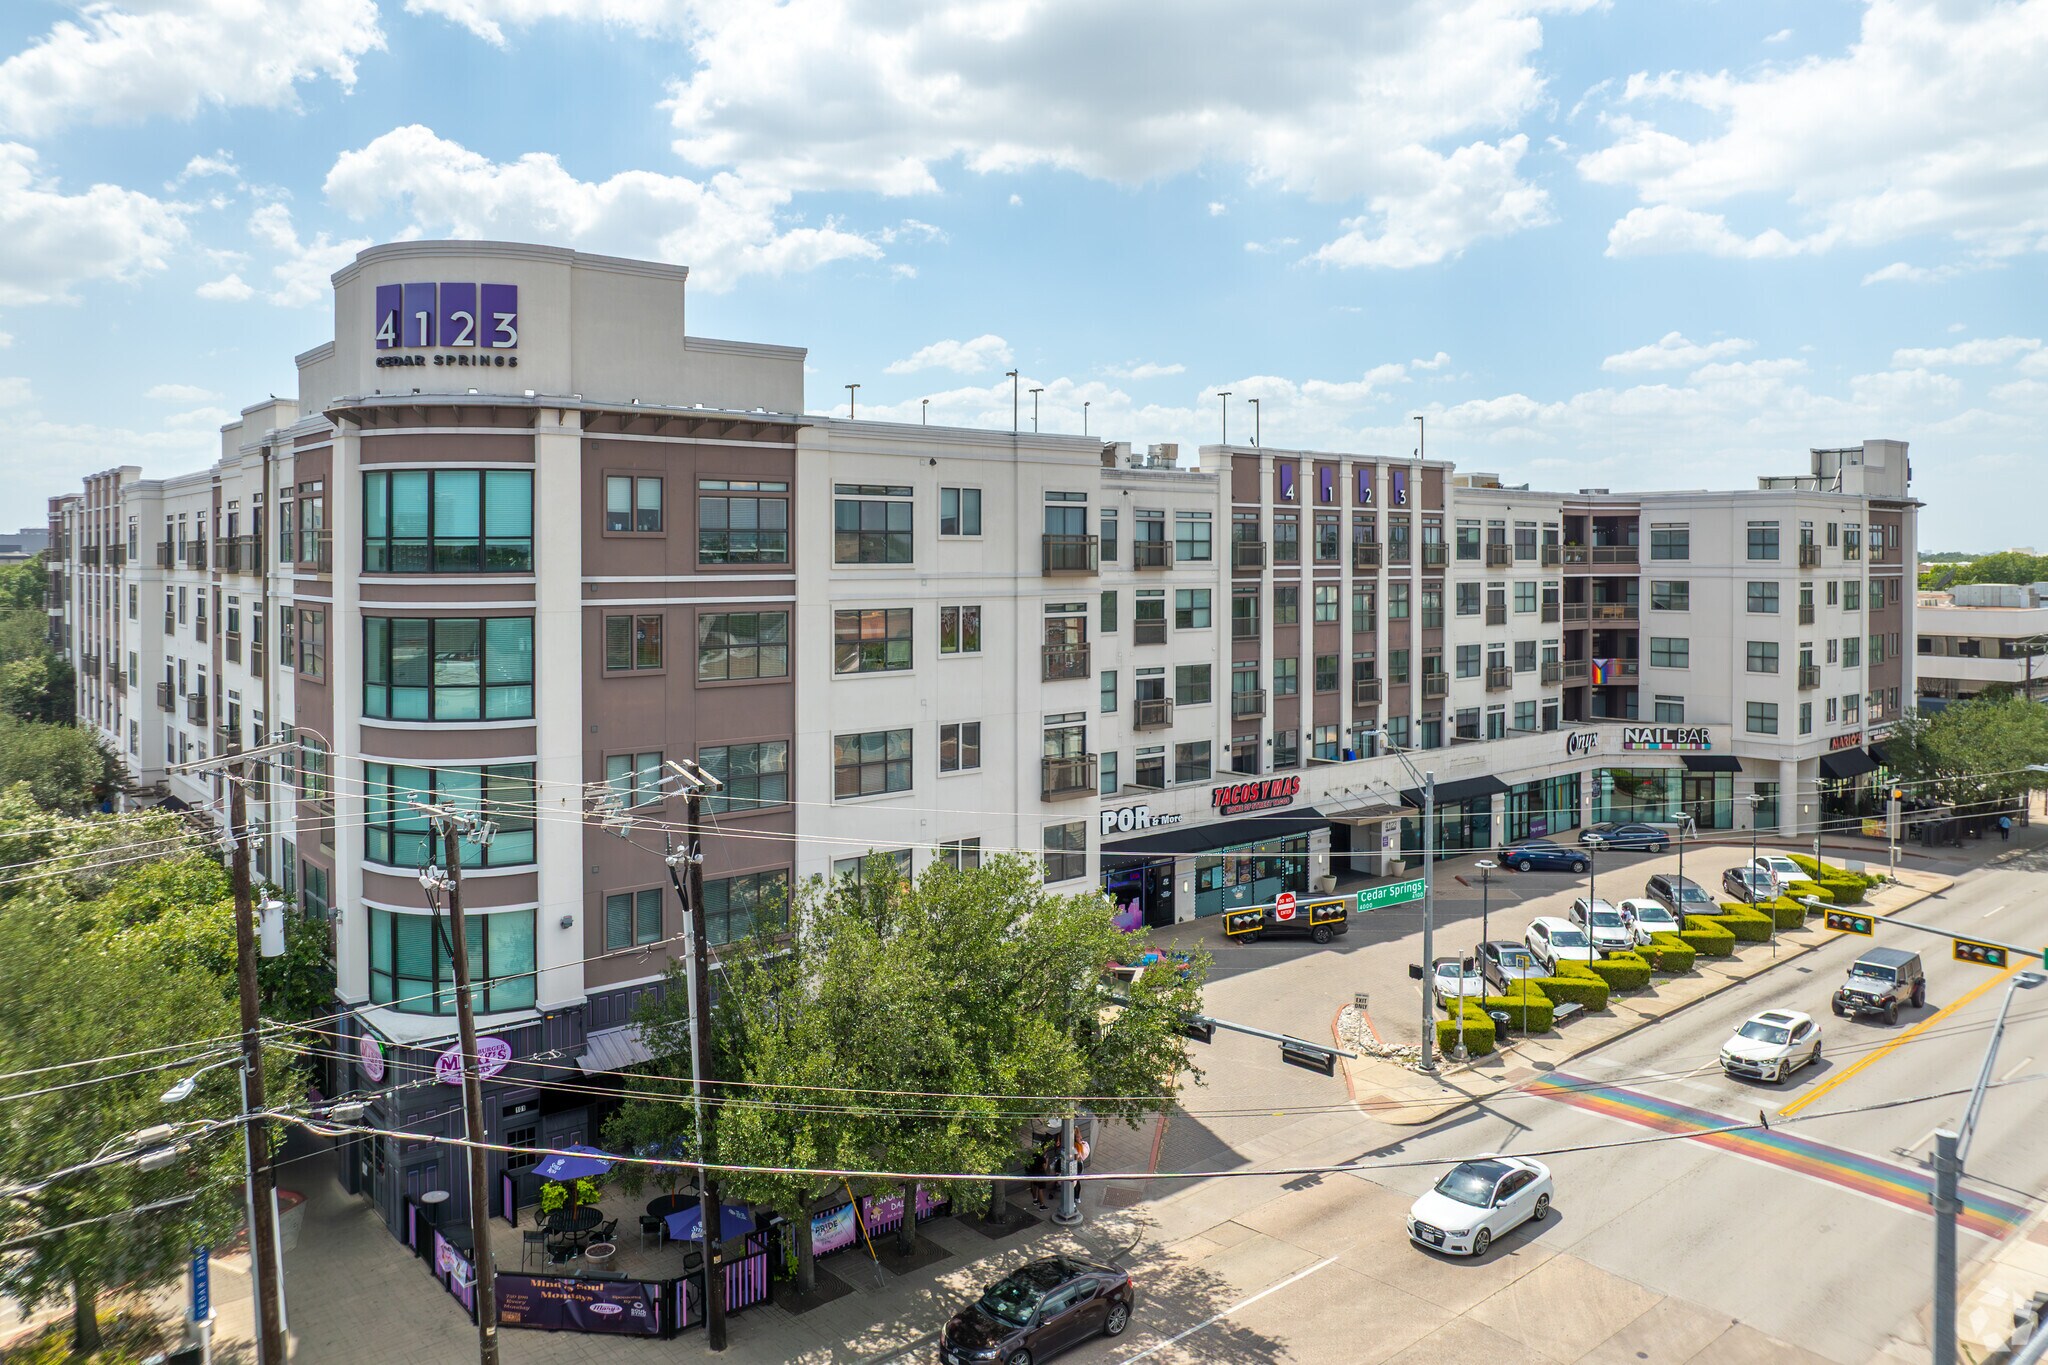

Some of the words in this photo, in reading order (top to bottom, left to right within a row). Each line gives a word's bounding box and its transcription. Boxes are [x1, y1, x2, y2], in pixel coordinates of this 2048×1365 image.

[376, 309, 518, 348] 4123
[376, 355, 425, 368] CEDAR
[433, 355, 518, 368] SPRINGS
[1568, 731, 1599, 755] Onyx
[1624, 728, 1673, 743] NAIL
[1678, 728, 1711, 743] BAR
[1832, 732, 1862, 750] MARIO'S
[1214, 783, 1260, 807] TACOS
[1262, 780, 1271, 799] Y
[1271, 776, 1301, 798] MAS
[1226, 805, 1244, 814] HOME
[1251, 801, 1273, 810] STREET
[1273, 797, 1290, 807] TACOS
[1102, 805, 1151, 835] POR
[1152, 817, 1159, 826] &
[1161, 814, 1183, 825] More
[1361, 889, 1386, 902] Cedar
[1389, 881, 1422, 897] Springs
[815, 1220, 839, 1234] PRIDE
[530, 1279, 561, 1288] Mind
[576, 1283, 604, 1291] Soul
[540, 1290, 594, 1302] Mondays
